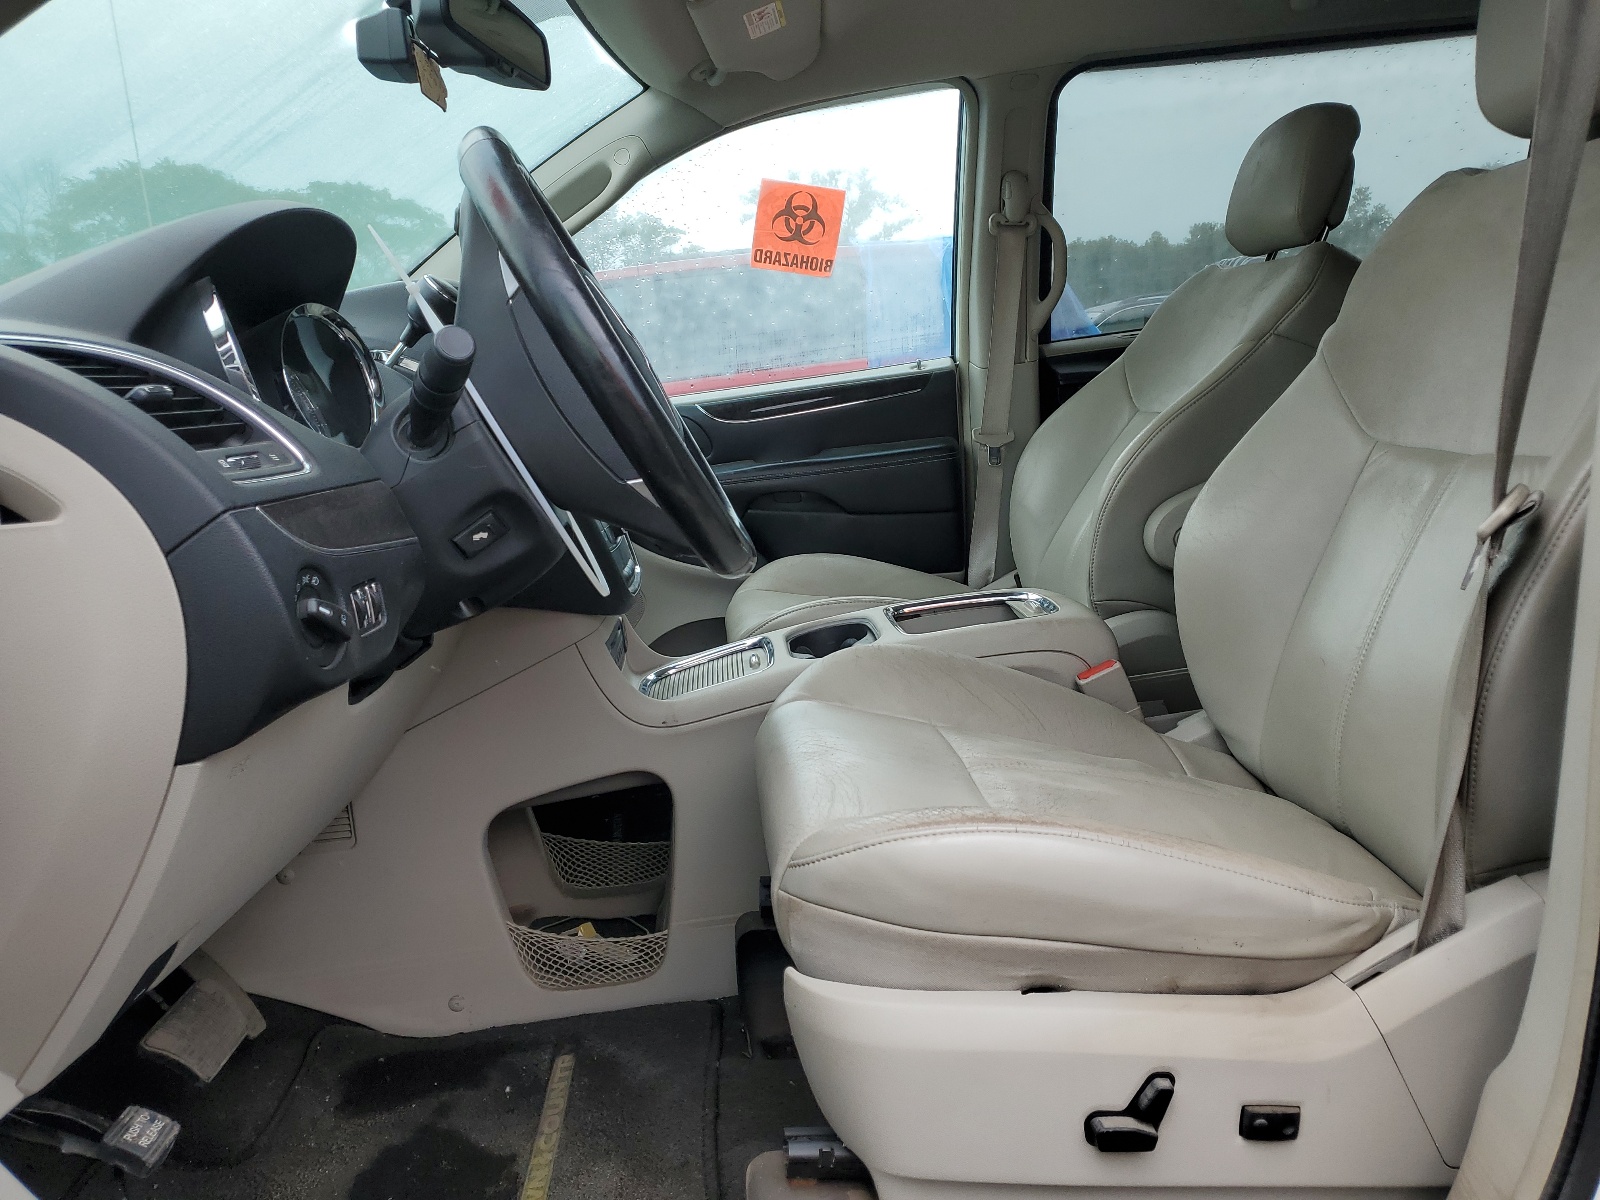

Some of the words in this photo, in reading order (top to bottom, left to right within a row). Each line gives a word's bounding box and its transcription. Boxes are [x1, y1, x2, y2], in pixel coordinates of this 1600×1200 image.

[123, 1123, 143, 1142] PUSH
[137, 1114, 150, 1124] TO
[138, 1119, 165, 1148] RELEASE
